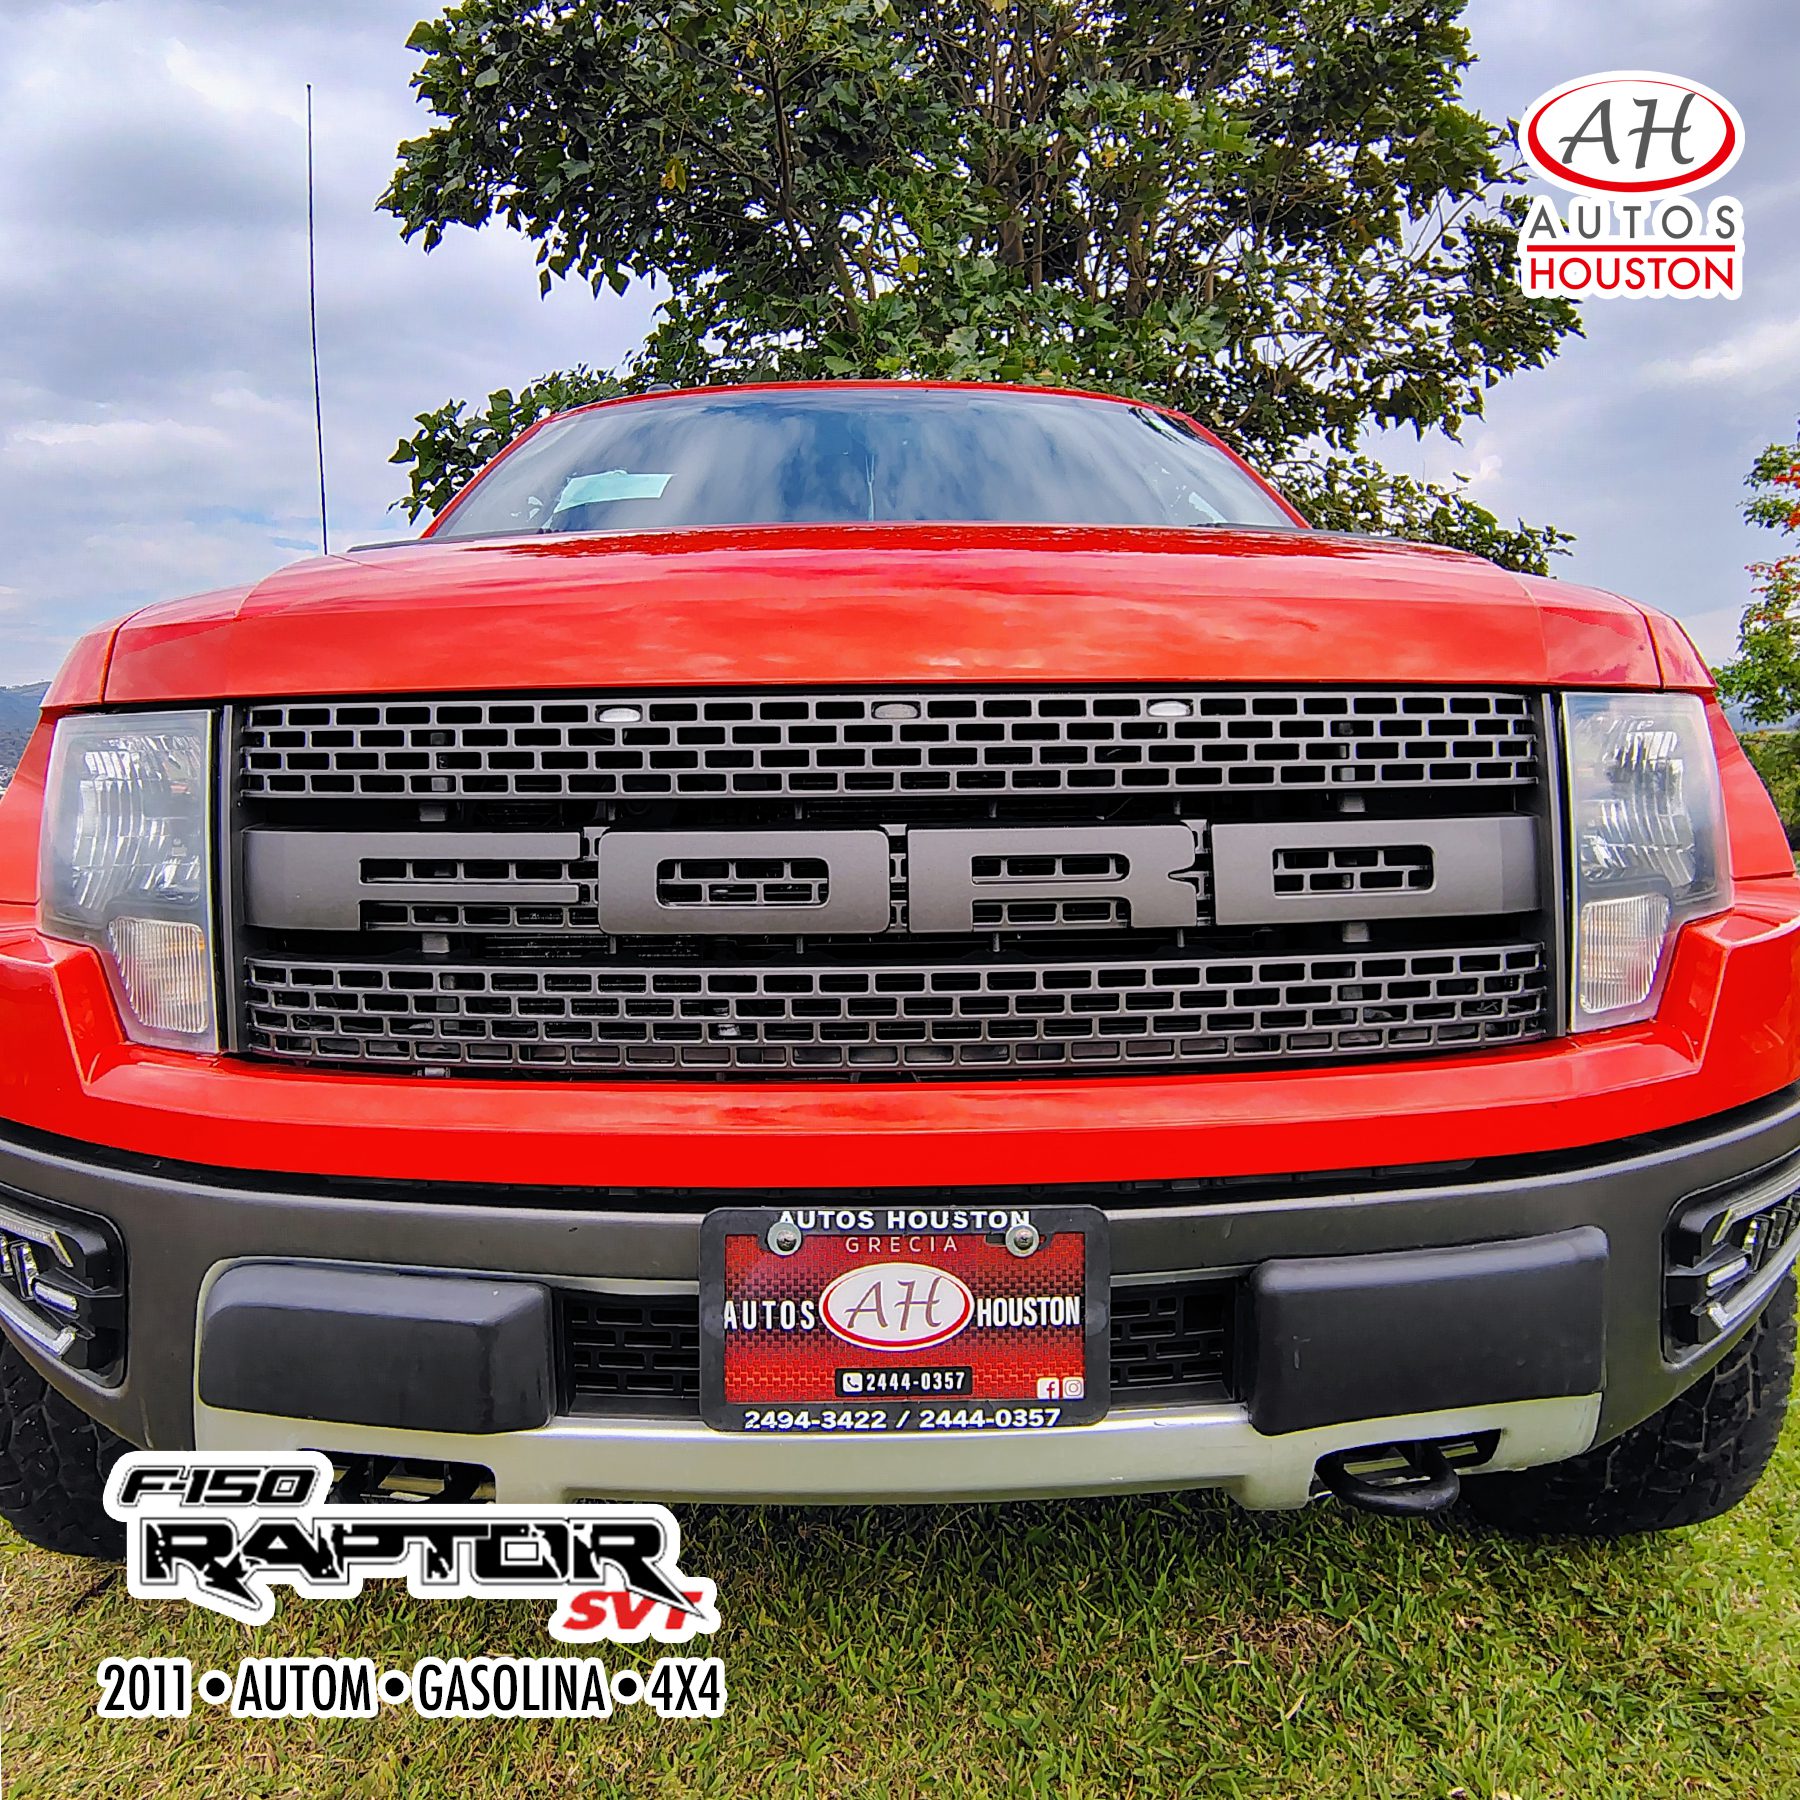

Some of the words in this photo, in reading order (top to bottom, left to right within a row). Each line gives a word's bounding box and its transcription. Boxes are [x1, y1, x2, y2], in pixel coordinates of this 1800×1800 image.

[245, 816, 1541, 934] FORD
[779, 1210, 875, 1230] AUTOS
[887, 1210, 1031, 1230] HOUSTON
[845, 1236, 958, 1254] GRECIA
[723, 1300, 815, 1330] AUTOS
[844, 1275, 944, 1332] AH
[977, 1296, 1081, 1328] HOUSTON
[865, 1372, 965, 1392] 2444-0357
[744, 1411, 887, 1431] 2494-3422
[896, 1411, 908, 1429] /
[919, 1408, 1062, 1429] 2444-0357
